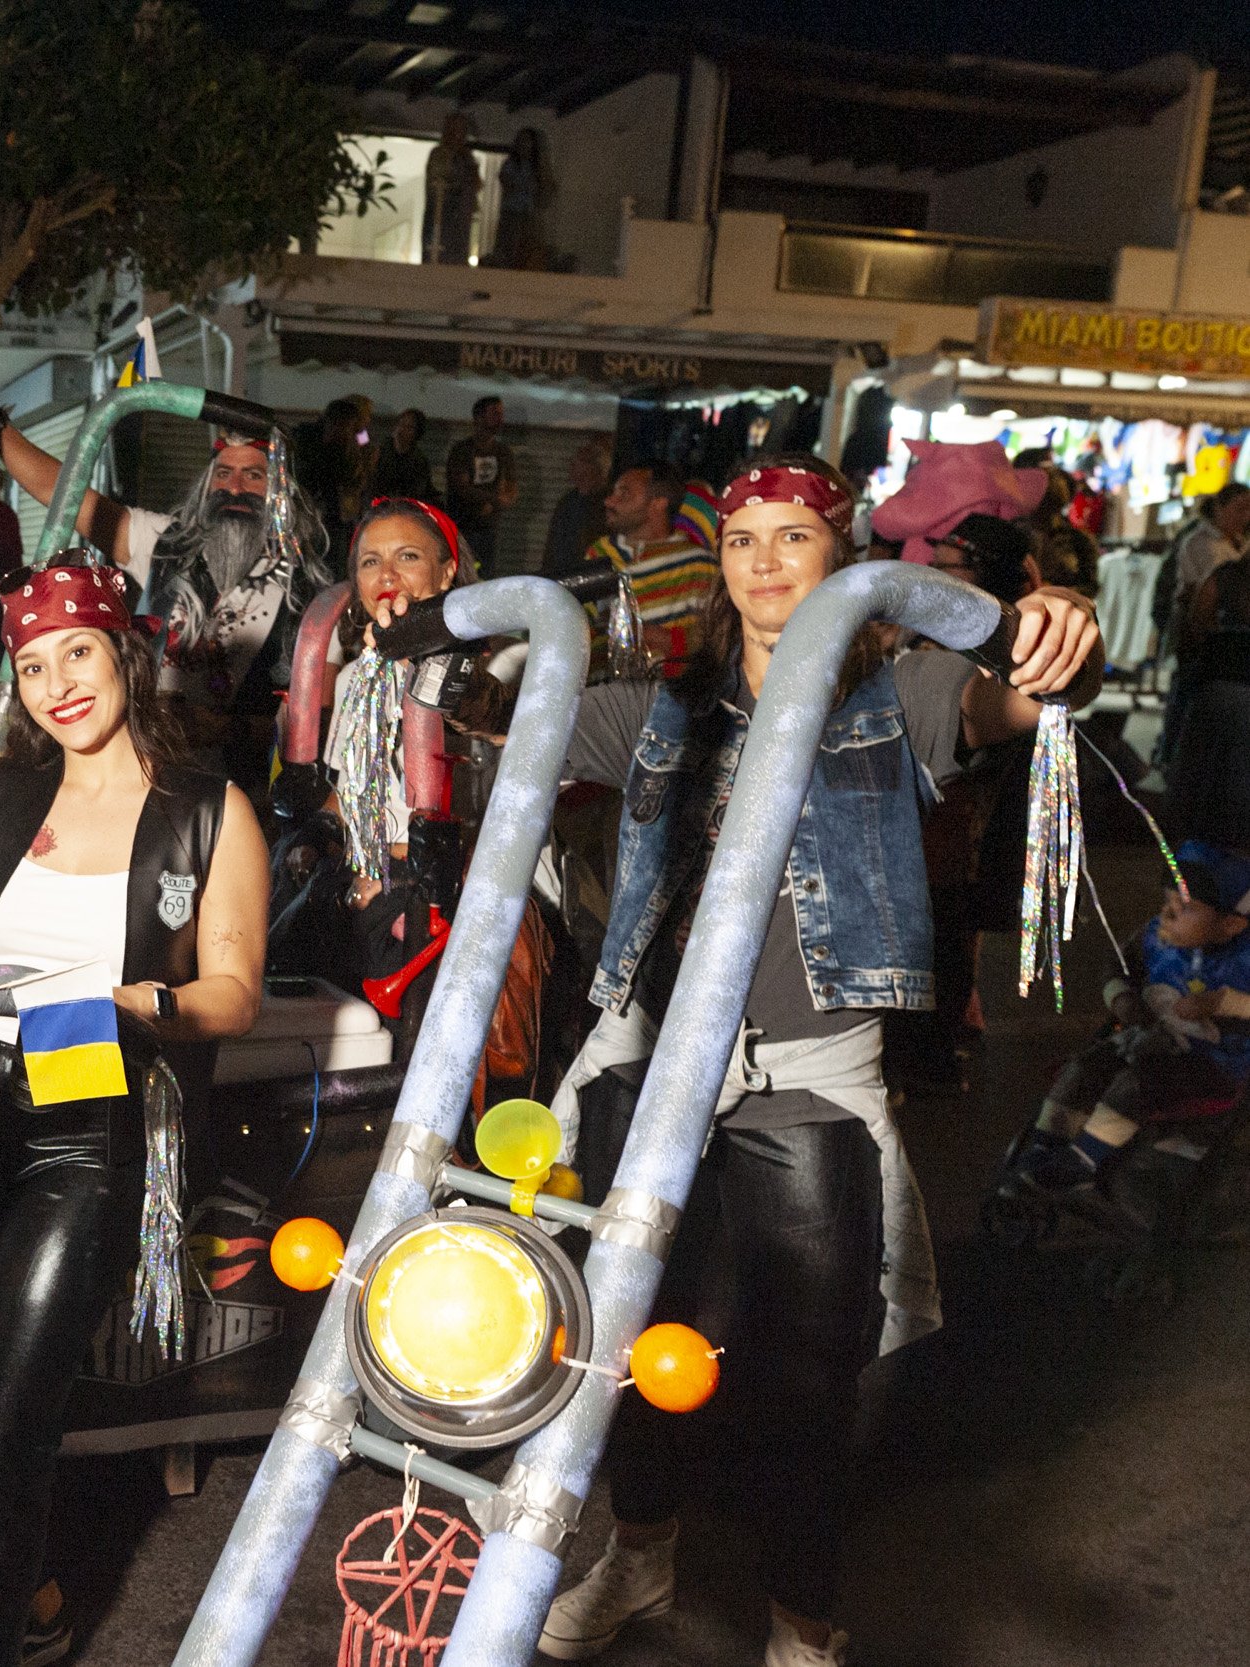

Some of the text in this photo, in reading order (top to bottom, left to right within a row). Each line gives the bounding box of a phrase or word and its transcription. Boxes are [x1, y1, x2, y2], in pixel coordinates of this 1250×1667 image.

[1014, 308, 1125, 350] MIAMI
[460, 343, 702, 382] MADHURI SPORTS
[163, 876, 192, 888] ROUTE
[164, 895, 186, 919] 69
